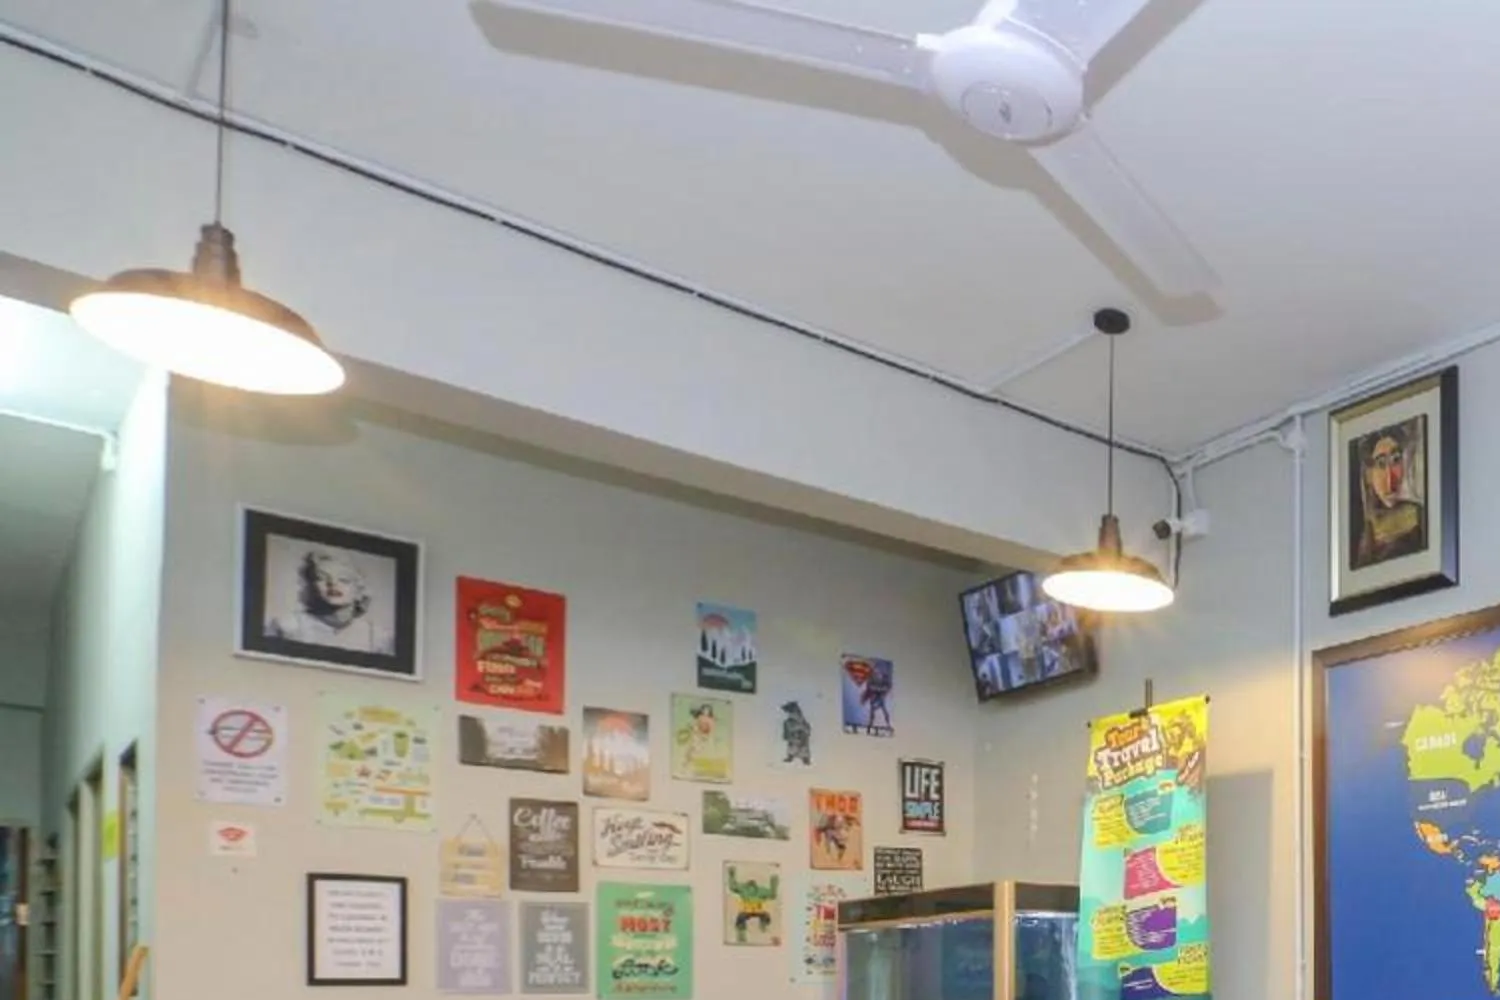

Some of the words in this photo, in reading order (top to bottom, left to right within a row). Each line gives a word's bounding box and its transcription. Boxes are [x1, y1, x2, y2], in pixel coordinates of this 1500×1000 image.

[1096, 727, 1160, 769] Travel
[905, 765, 940, 800] LIFE
[513, 806, 572, 838] Coffee
